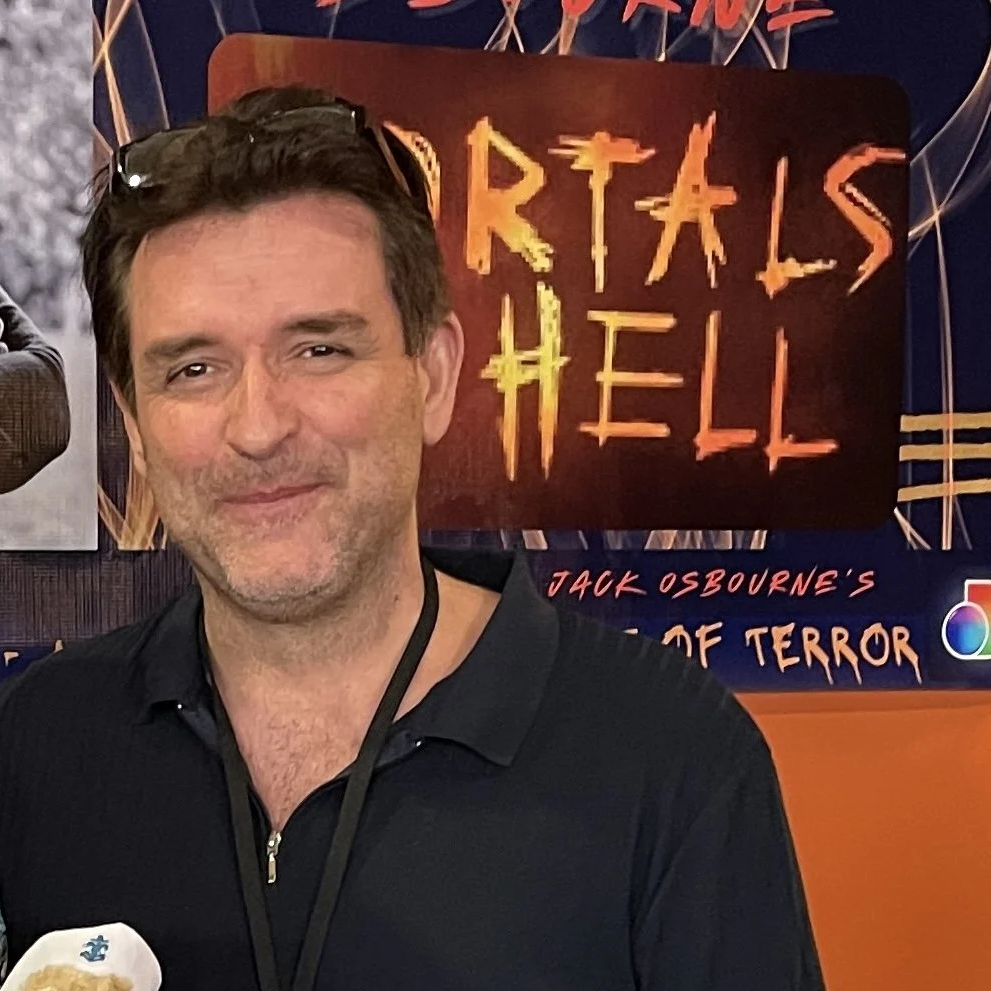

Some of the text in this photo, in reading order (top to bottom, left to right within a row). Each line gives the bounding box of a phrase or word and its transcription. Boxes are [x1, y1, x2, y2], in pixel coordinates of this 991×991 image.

[383, 110, 907, 298] RTALS
[481, 280, 840, 482] HELL
[547, 565, 876, 600] JACK OSBOURNE'S
[745, 622, 923, 685] TERROR
